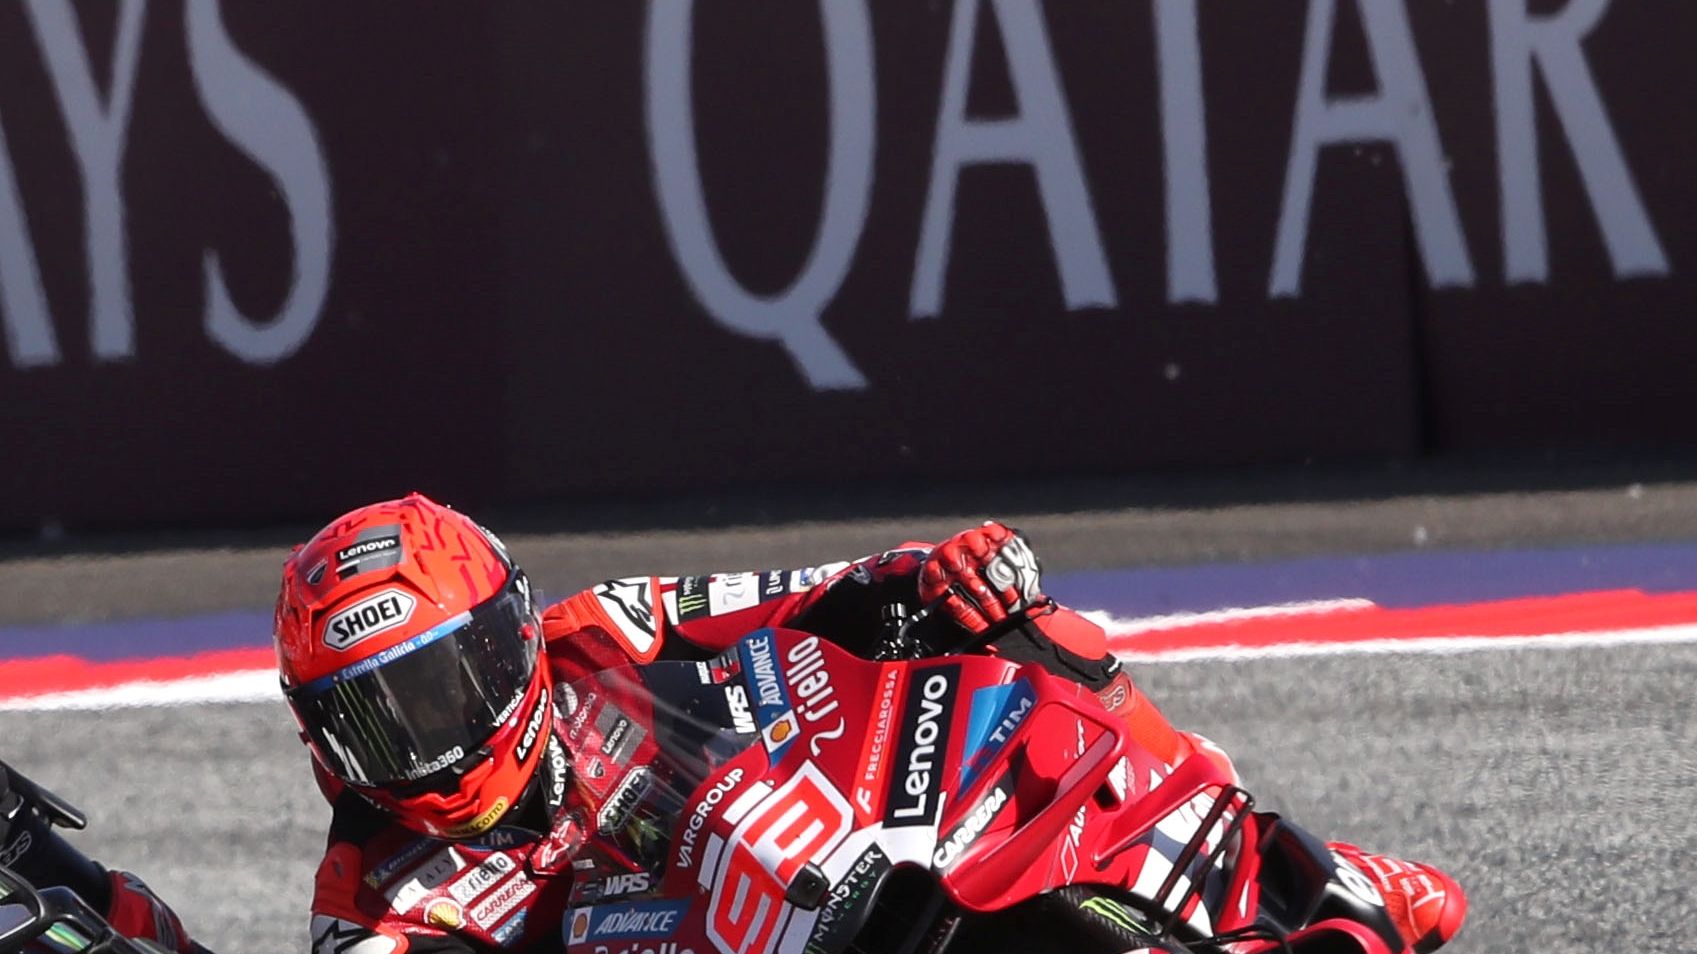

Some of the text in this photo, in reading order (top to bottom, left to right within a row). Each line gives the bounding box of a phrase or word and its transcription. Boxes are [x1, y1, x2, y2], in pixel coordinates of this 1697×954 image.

[331, 597, 403, 644] SHOEI
[747, 636, 784, 706] ADVANCE
[784, 636, 840, 722] riello
[866, 668, 898, 781] FRECCIAROSSA
[893, 674, 949, 818] Lenovo
[989, 697, 1033, 744] TIM
[405, 746, 465, 780] Insta360
[549, 733, 567, 807] Lenov
[676, 768, 745, 869] VARGROUP
[933, 787, 1008, 869] CARRERA
[594, 908, 678, 936] ADVANCE
[814, 851, 883, 942] MONSTER
